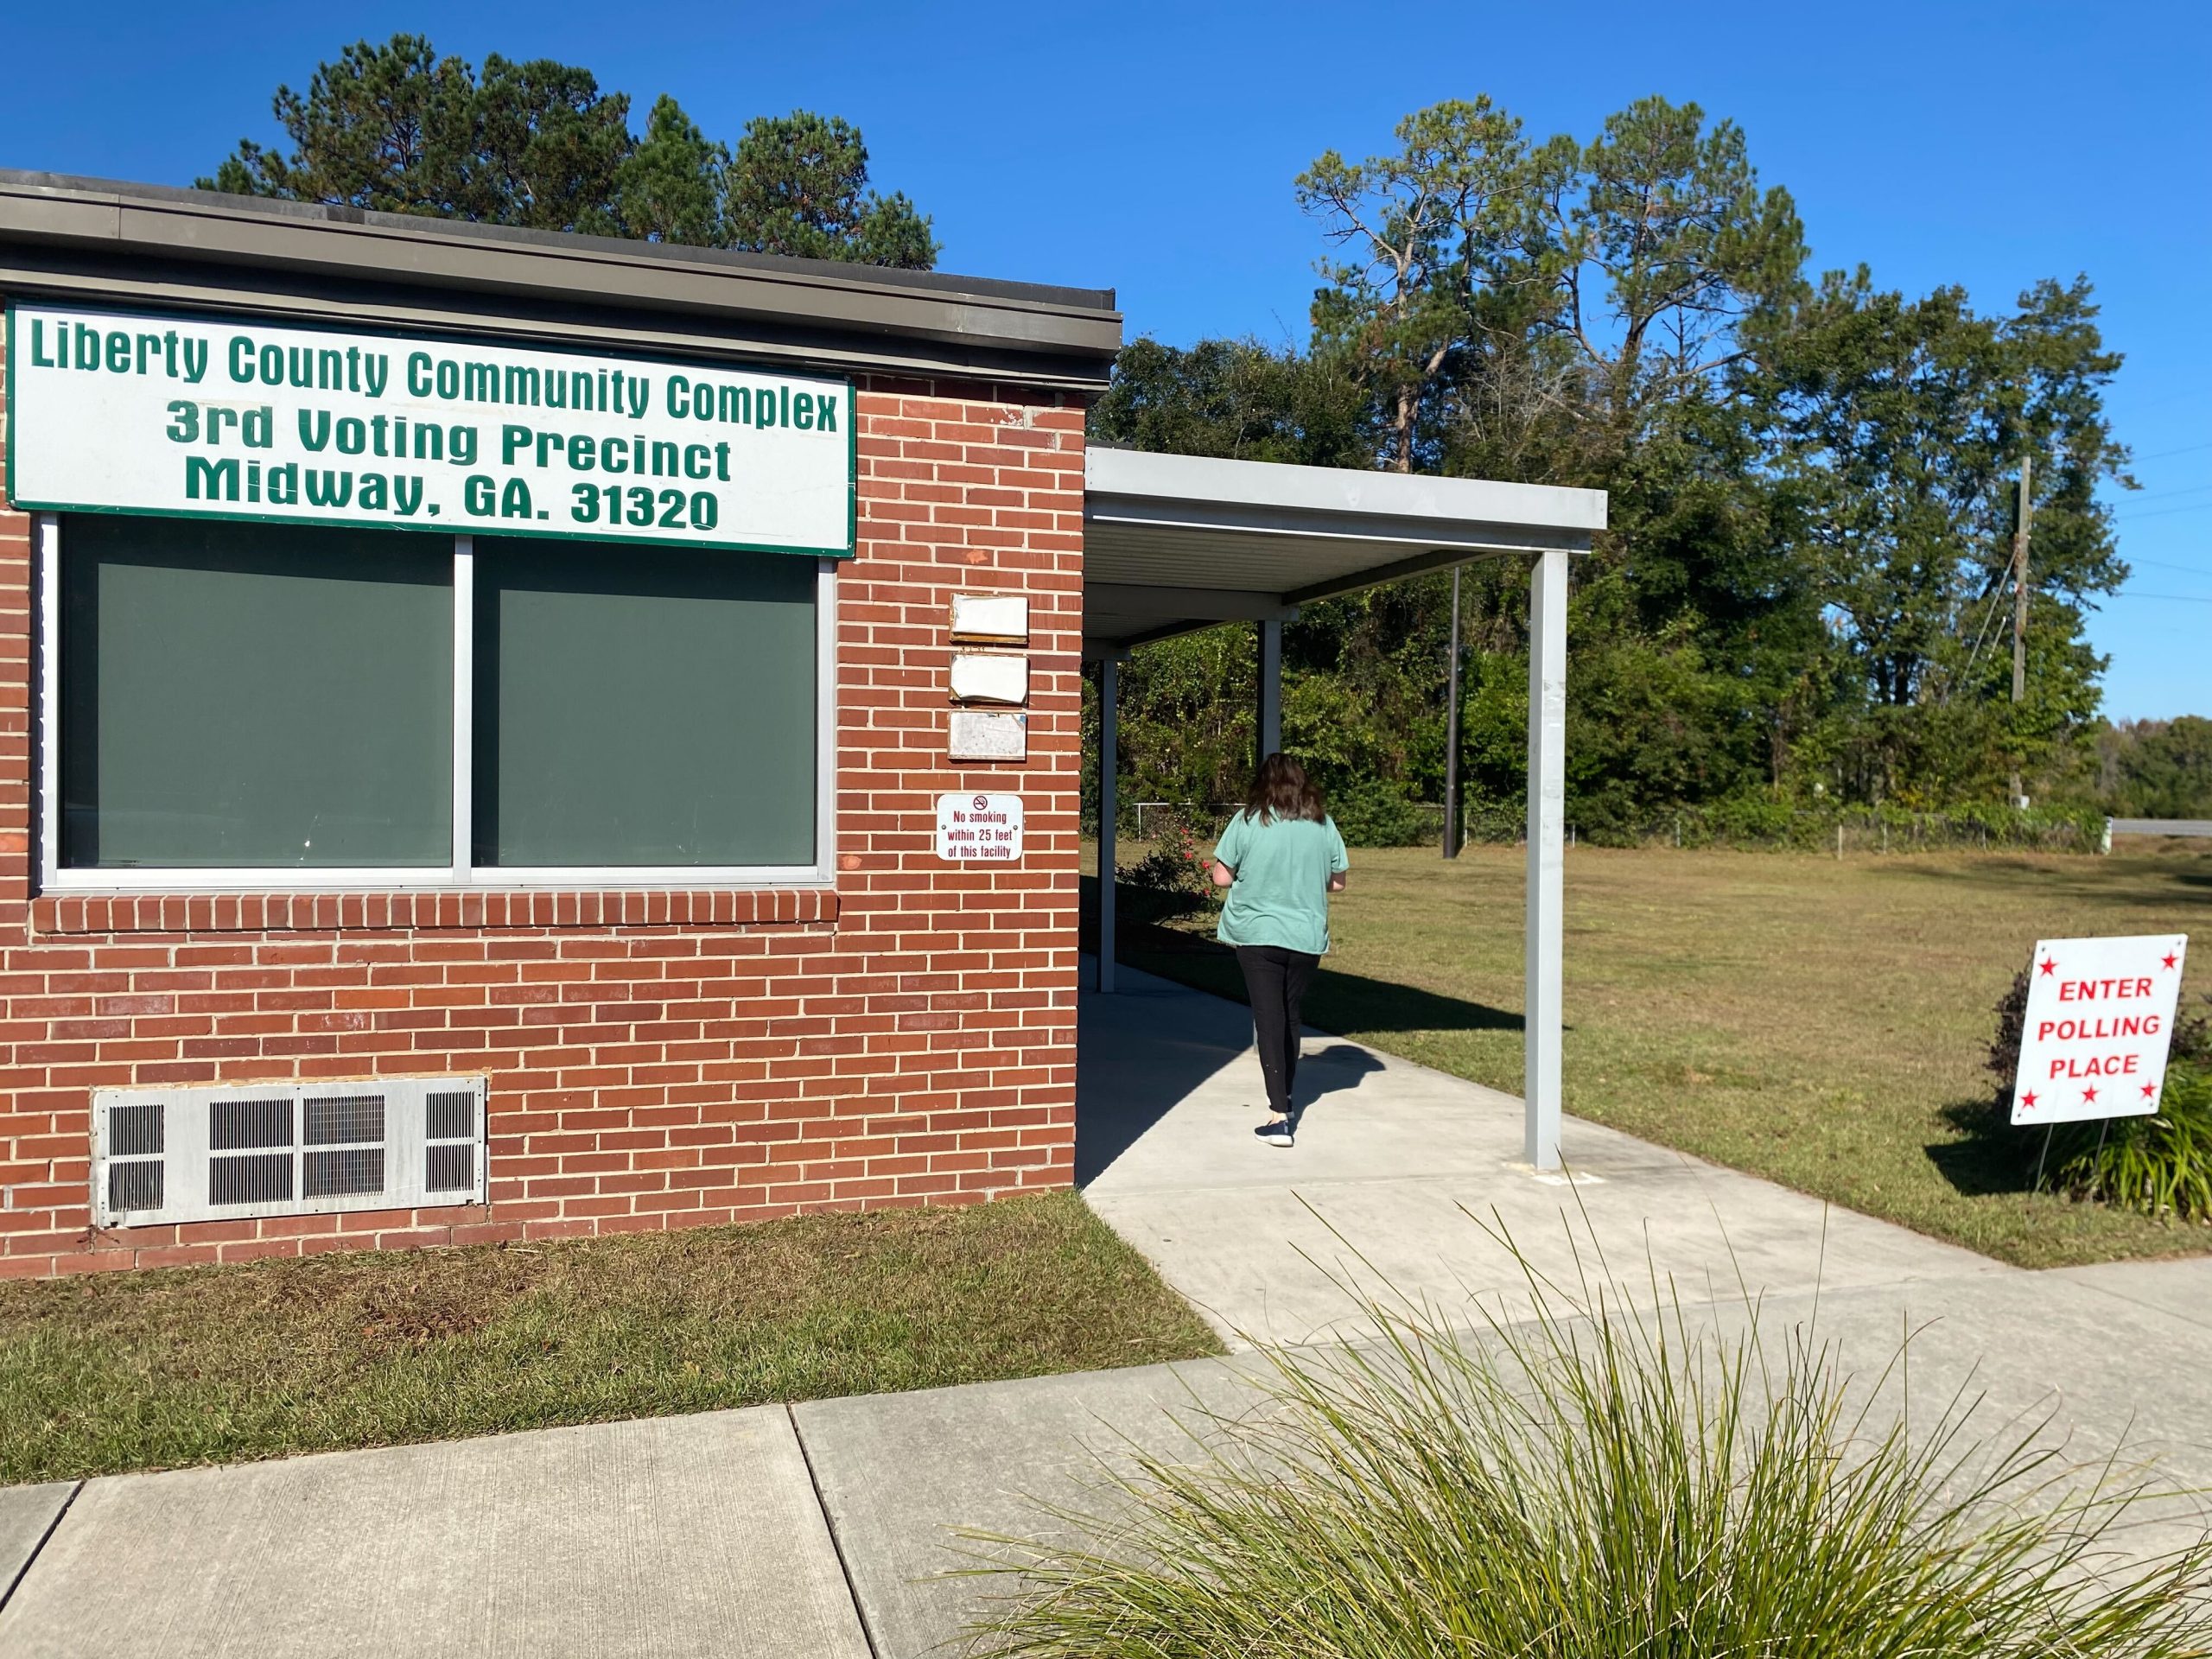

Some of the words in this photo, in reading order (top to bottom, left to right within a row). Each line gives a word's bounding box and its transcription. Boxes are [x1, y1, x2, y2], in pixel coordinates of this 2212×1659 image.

[31, 318, 208, 383] Liberty
[229, 335, 388, 398] County
[407, 351, 650, 419] Community
[666, 375, 837, 432] Complex
[166, 400, 273, 448] 3rd
[298, 409, 478, 466] Voting
[502, 424, 731, 481] Precinct
[186, 455, 441, 517] Midway,
[464, 474, 550, 520] GA.
[571, 482, 718, 531] 31320
[953, 810, 966, 823] No
[969, 810, 1007, 824] smoking
[947, 829, 975, 841] within
[978, 830, 991, 841] 25
[995, 830, 1013, 841] feet
[948, 845, 957, 857] of
[960, 845, 977, 857] this
[981, 845, 1011, 859] facility
[2059, 977, 2152, 1001] ENTER
[2037, 1015, 2161, 1041] POLLING
[2050, 1054, 2139, 1079] PLACE
